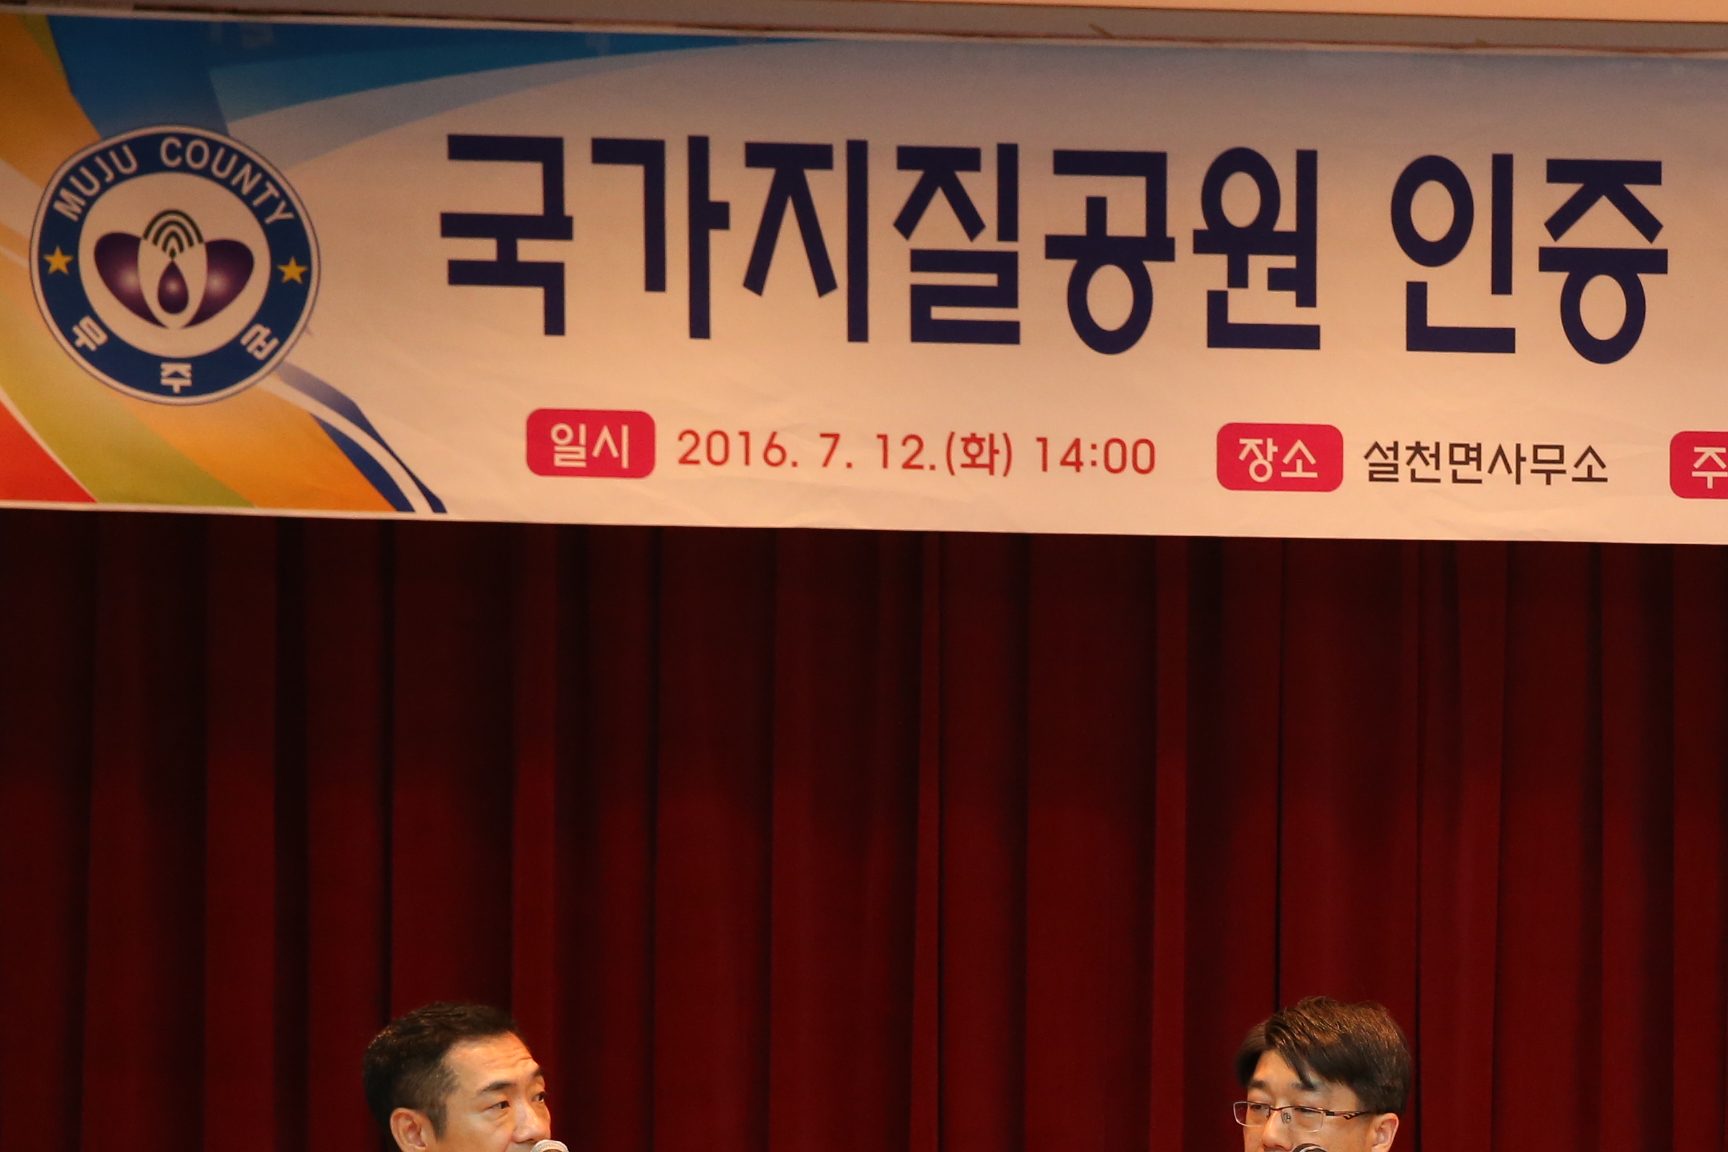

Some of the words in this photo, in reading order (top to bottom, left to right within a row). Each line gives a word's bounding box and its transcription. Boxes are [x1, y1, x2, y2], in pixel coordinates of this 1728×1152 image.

[53, 145, 138, 222] MUJU
[160, 137, 294, 224] COUNTY
[440, 133, 1320, 354] 국가지질공원
[1391, 153, 1668, 364] 인증
[551, 424, 628, 468] 일시
[678, 429, 798, 467] 2016.
[820, 433, 852, 468] 7.
[877, 432, 1012, 477] 12.(화)
[1036, 437, 1155, 474] 14:00
[1239, 438, 1318, 482] 장소
[1364, 441, 1608, 485] 설천면사무소
